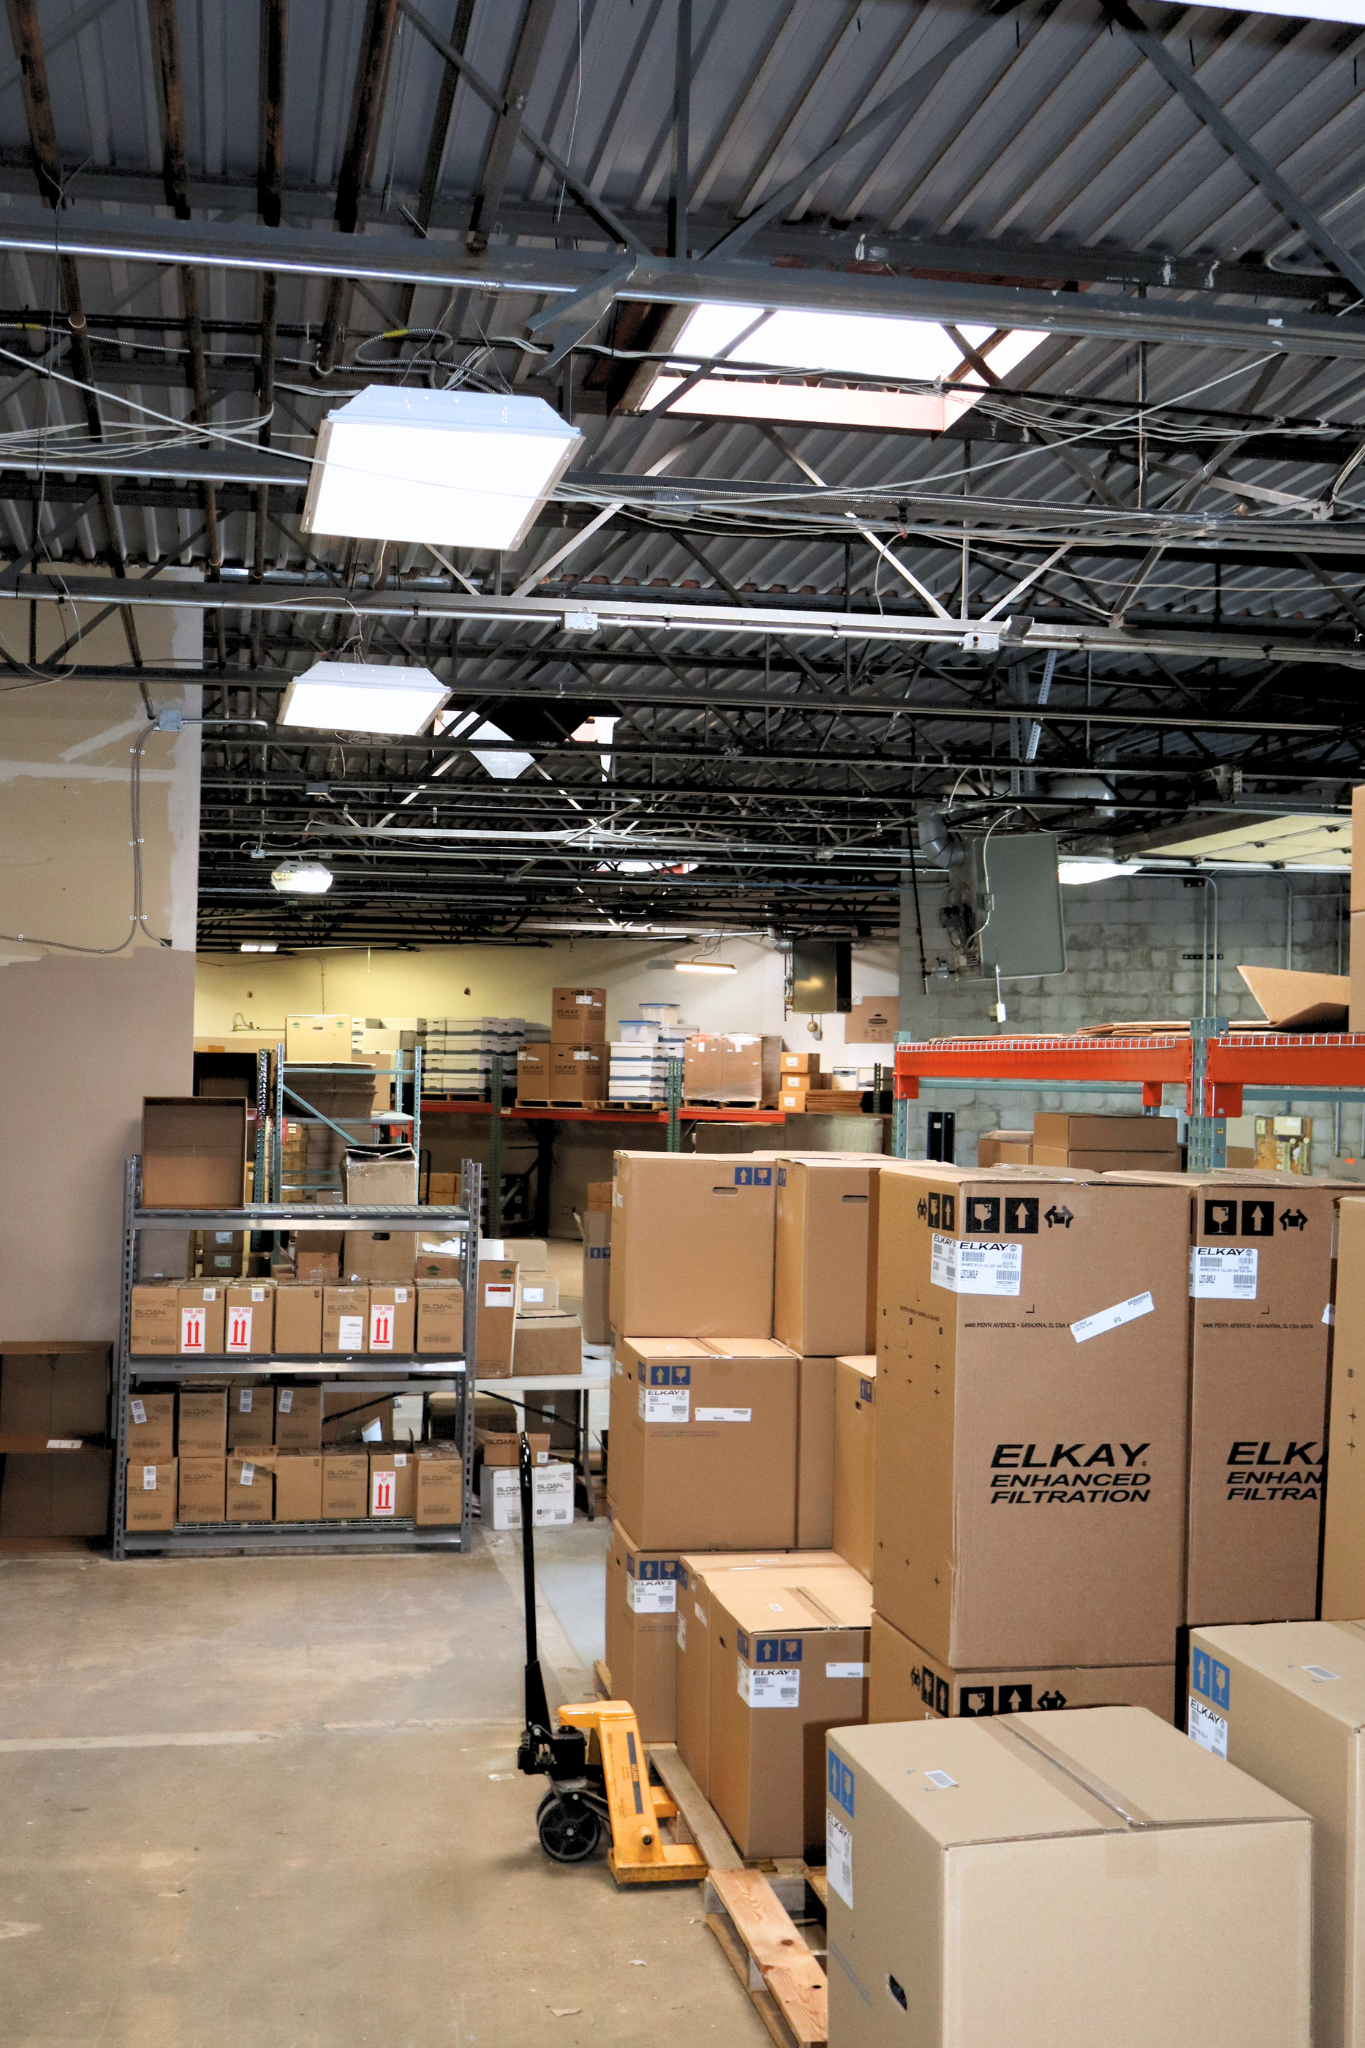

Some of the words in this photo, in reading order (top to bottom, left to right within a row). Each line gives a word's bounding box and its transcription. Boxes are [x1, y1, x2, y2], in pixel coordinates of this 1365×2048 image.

[934, 1234, 953, 1245] ELKAY
[959, 1242, 1009, 1251] ELKAY
[1197, 1248, 1246, 1256] ELKAY
[990, 1443, 1151, 1468] ELKAY
[990, 1473, 1151, 1487] ENHANCED
[991, 1490, 1151, 1504] FILTRATION
[1227, 1488, 1322, 1501] FILTRA
[1191, 1698, 1220, 1724] ELKAY
[827, 1811, 848, 1838] ELKAY
